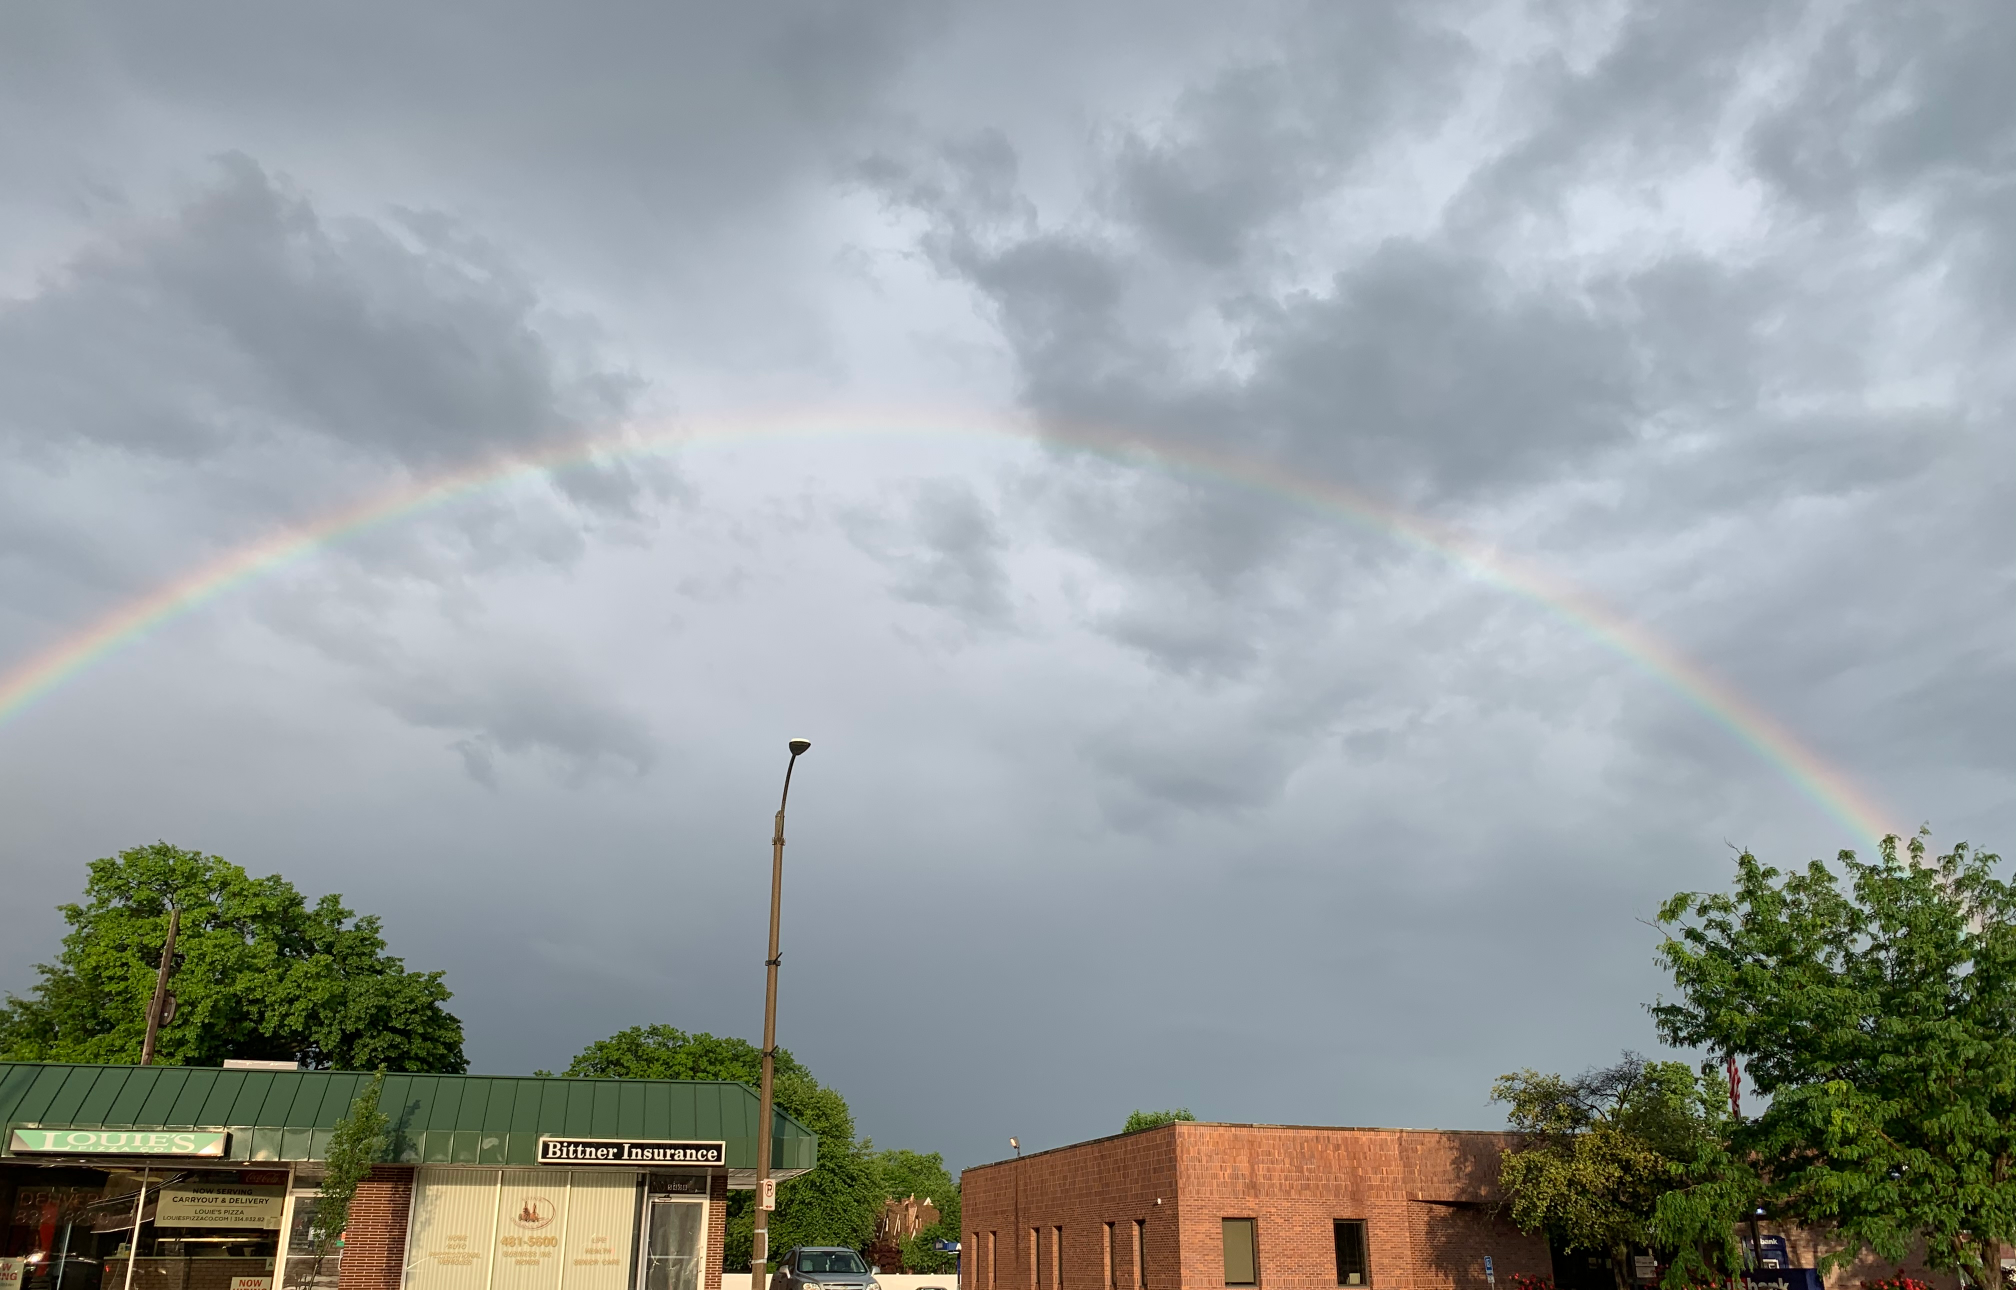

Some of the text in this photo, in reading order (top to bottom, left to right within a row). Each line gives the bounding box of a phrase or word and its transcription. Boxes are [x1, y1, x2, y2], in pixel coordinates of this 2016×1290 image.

[42, 1132, 195, 1151] LOUIE'S
[546, 1141, 718, 1161] Bittner Insurance
[216, 1188, 253, 1196] SERVING
[172, 1196, 220, 1204] CARRYOUT
[228, 1197, 270, 1205] DELIVERY
[238, 1279, 263, 1288] NOW
